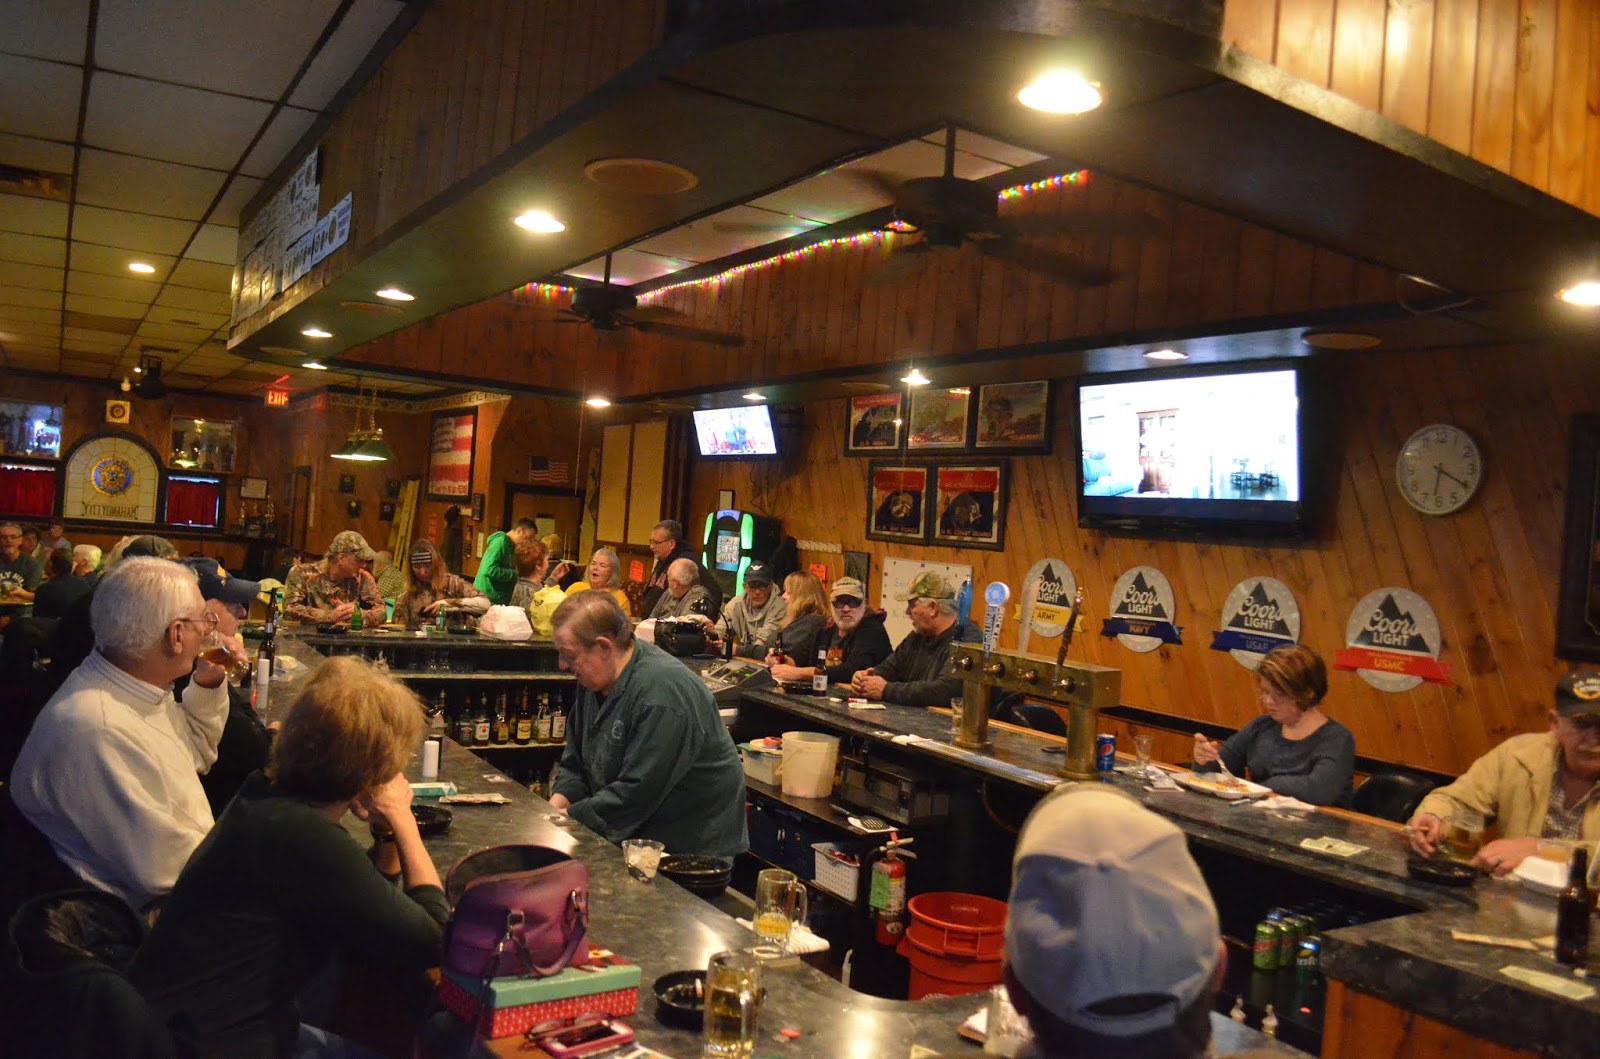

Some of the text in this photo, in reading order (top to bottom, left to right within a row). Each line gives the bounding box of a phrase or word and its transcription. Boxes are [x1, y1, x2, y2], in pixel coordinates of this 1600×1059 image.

[268, 391, 287, 406] EXIT
[1037, 592, 1060, 603] LIGHT
[1123, 584, 1160, 606] Coors
[1127, 603, 1154, 615] LIGHT
[1238, 596, 1282, 621] Coors
[1037, 611, 1056, 621] ARMY
[1365, 608, 1418, 637] Coors
[1129, 624, 1150, 634] NAVY
[1243, 616, 1276, 630] LIGHT
[1245, 640, 1269, 652] USAF
[1373, 632, 1410, 647] LIGHT
[1373, 658, 1406, 671] USMC
